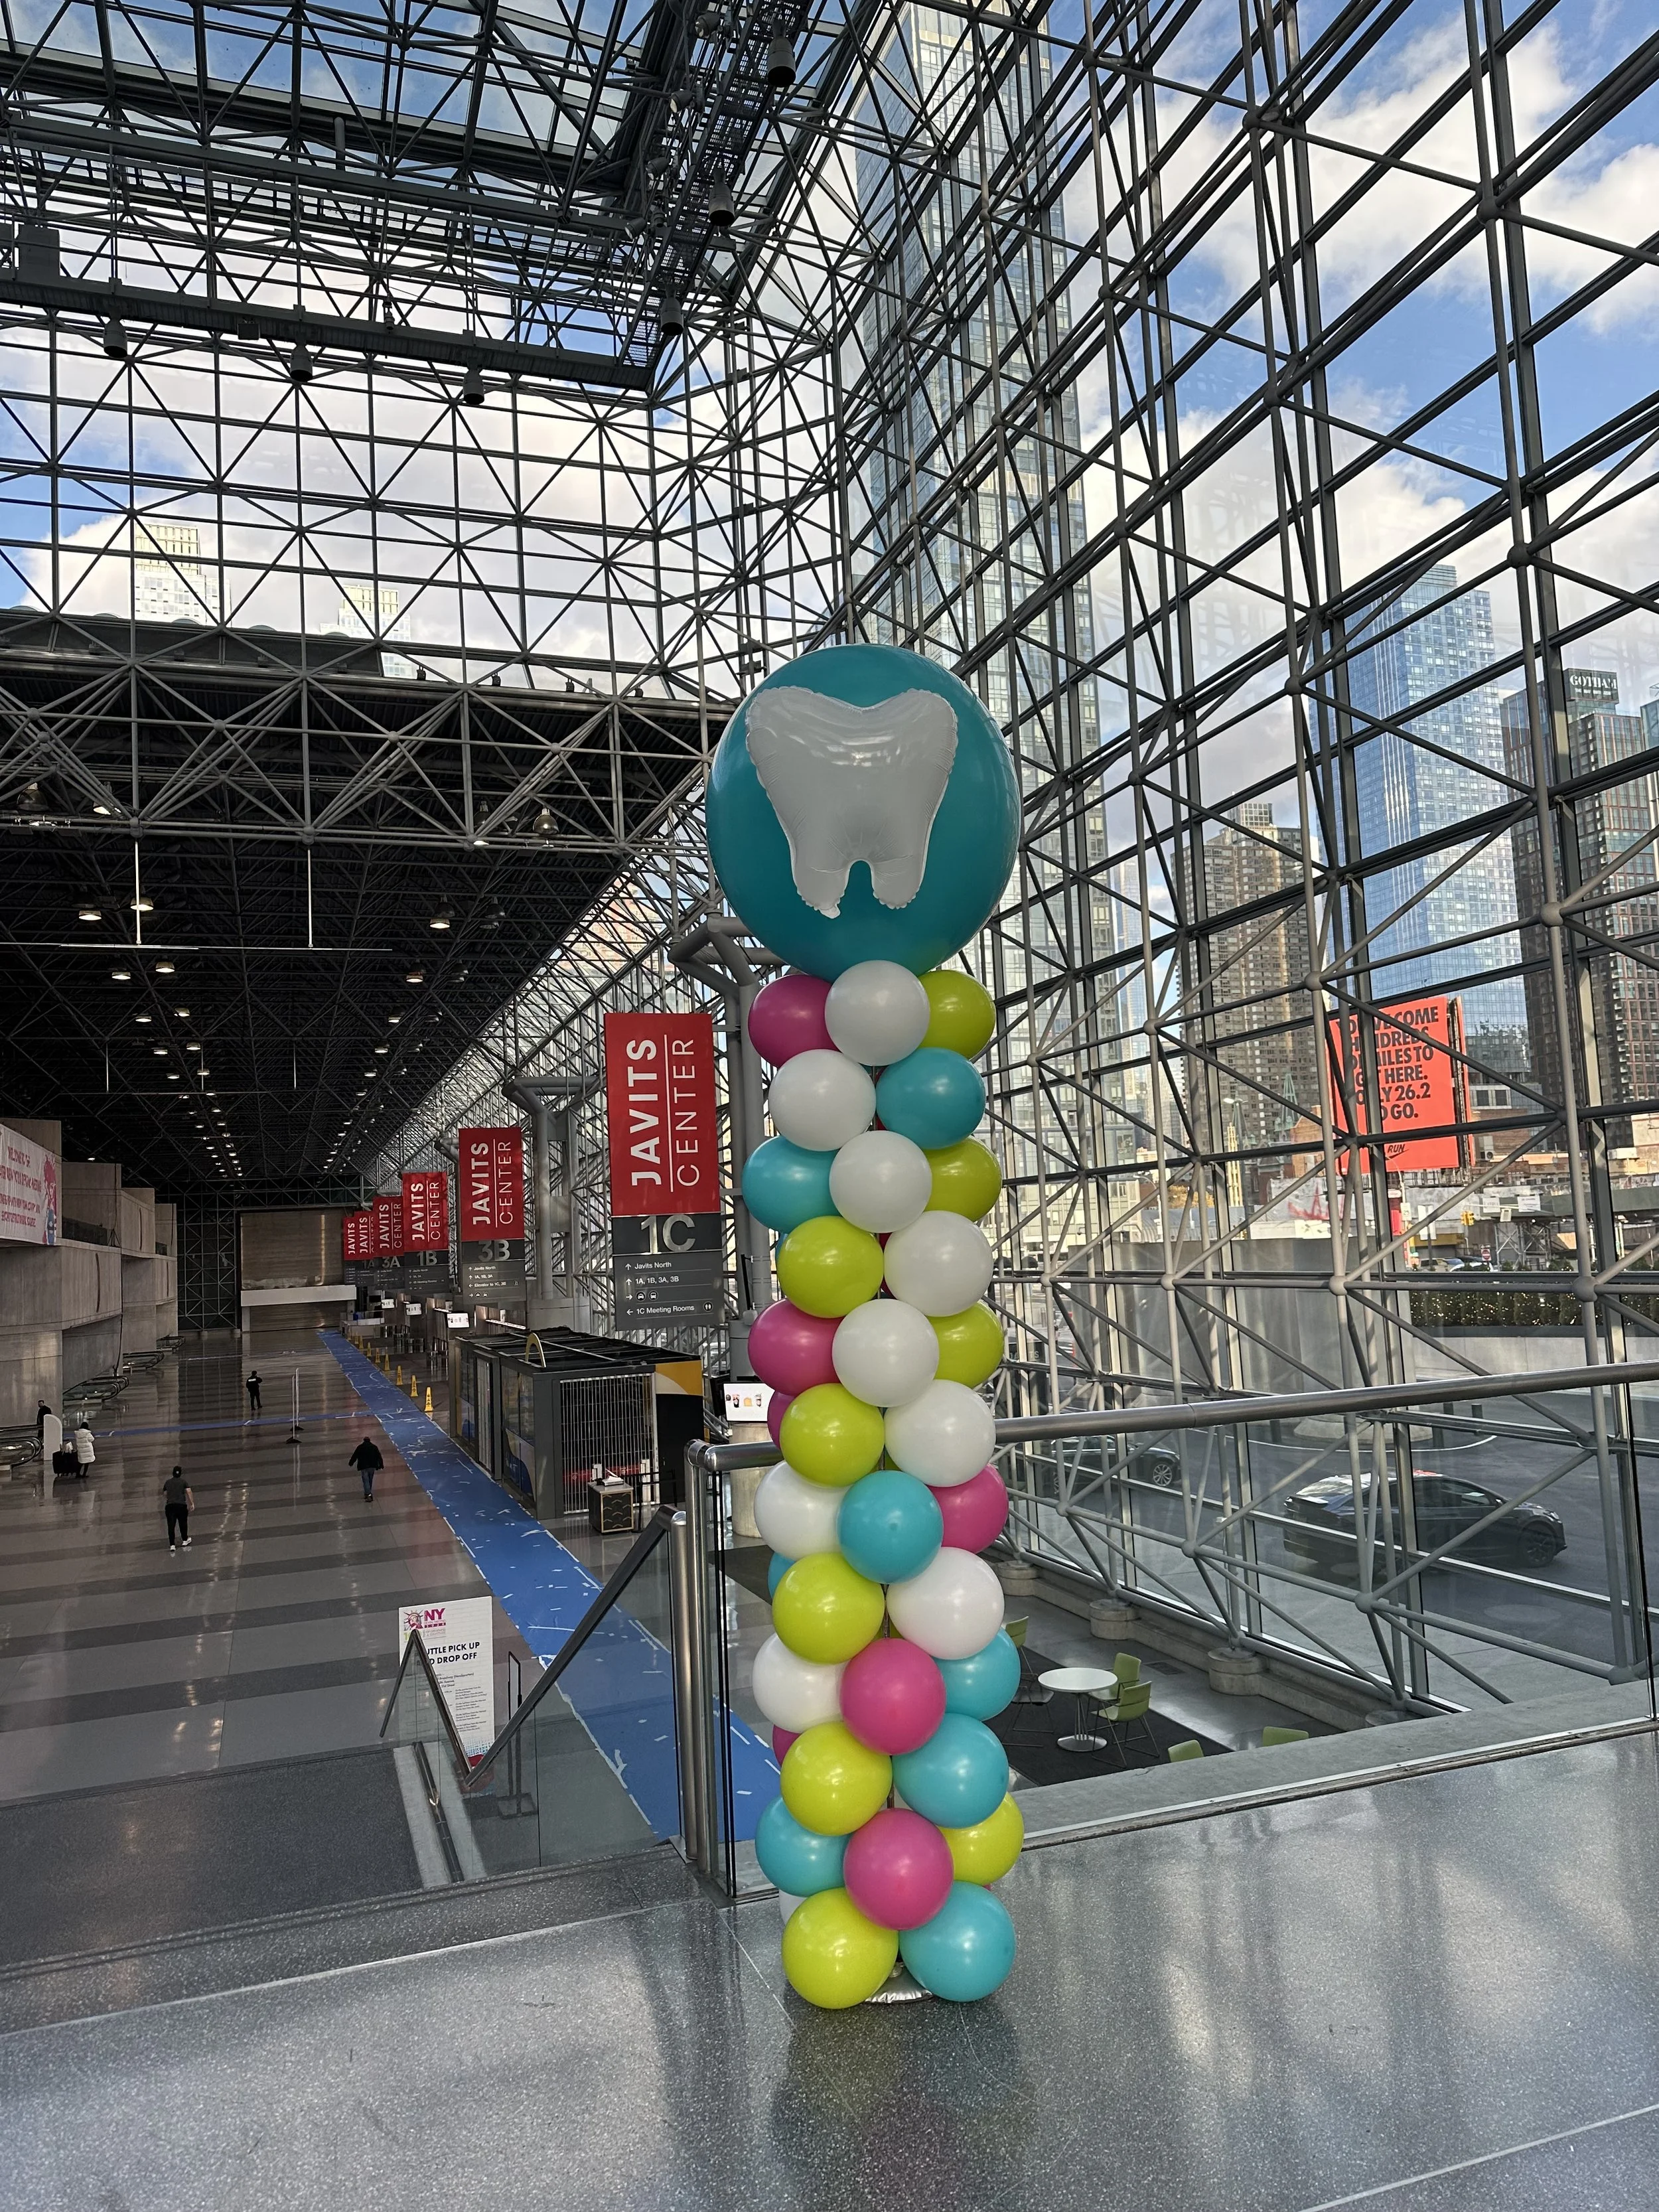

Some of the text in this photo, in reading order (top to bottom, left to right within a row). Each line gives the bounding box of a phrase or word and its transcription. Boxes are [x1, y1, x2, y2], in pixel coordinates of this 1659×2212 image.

[1413, 1045, 1433, 1061] TO
[1384, 1065, 1428, 1084] HERE.
[1395, 1082, 1431, 1101] 26.2
[626, 1039, 662, 1186] JAVITS
[672, 1039, 700, 1187] CENTER
[1390, 1102, 1419, 1120] GO.
[1388, 1144, 1406, 1153] RUN
[470, 1142, 491, 1225] JAVITS
[498, 1142, 514, 1224] CENTER
[411, 1182, 425, 1241] JAVITS
[429, 1181, 441, 1240] CENTER
[359, 1217, 368, 1254] JAVITS
[379, 1204, 390, 1248] JAVITS
[393, 1203, 402, 1248] CENTER
[640, 1214, 695, 1254] 1C
[347, 1222, 356, 1255] JAVITS
[382, 1256, 401, 1268] 3A
[416, 1250, 438, 1267] 1B
[478, 1240, 510, 1262] 3B
[646, 1306, 672, 1315] Meeting
[424, 1607, 446, 1621] NY
[437, 1655, 461, 1664] DROP
[462, 1652, 477, 1660] OFF
[448, 1643, 467, 1653] PICK
[469, 1641, 480, 1650] UP
